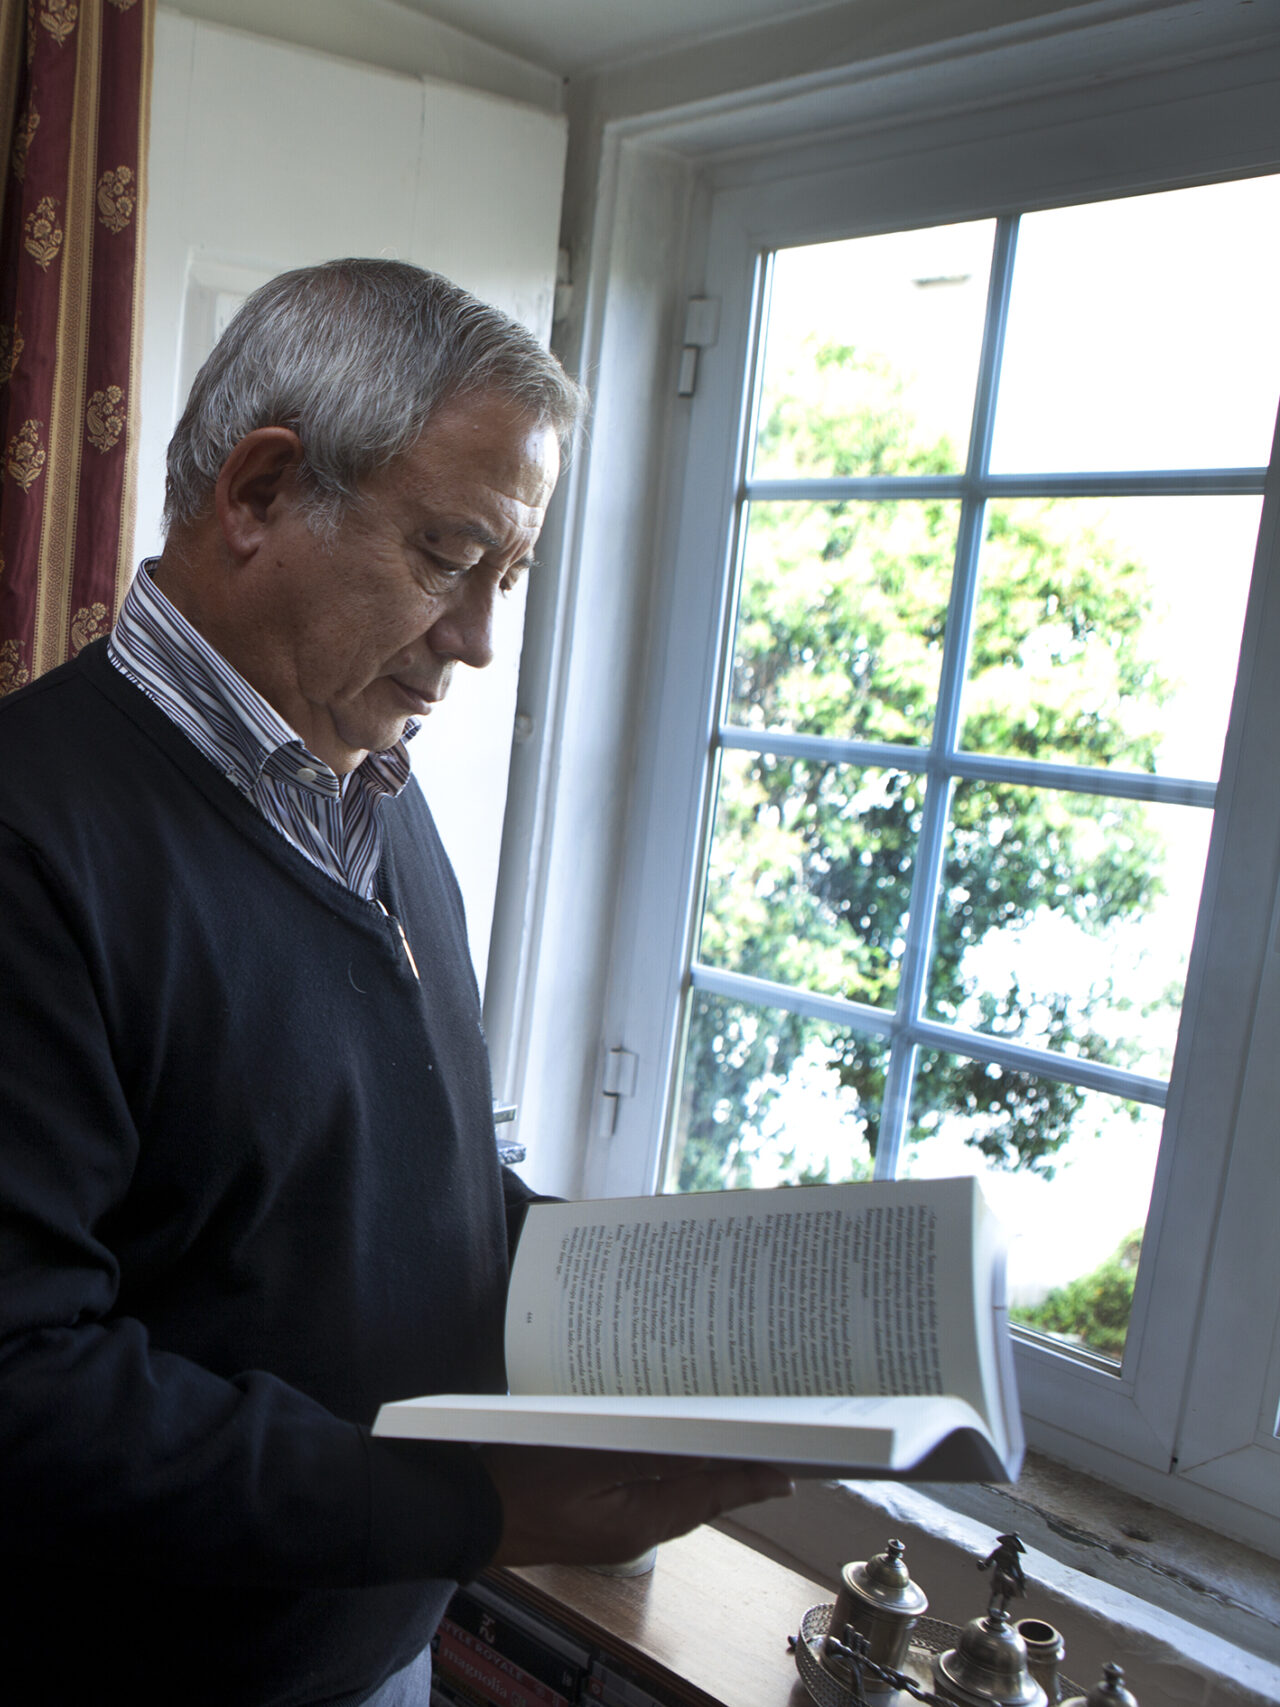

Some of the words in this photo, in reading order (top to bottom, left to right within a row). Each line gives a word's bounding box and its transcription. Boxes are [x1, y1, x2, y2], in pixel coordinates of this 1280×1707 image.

[478, 1613, 497, 1644] 24
[443, 1647, 508, 1699] magnolia
[475, 1642, 522, 1681] ROYALE
